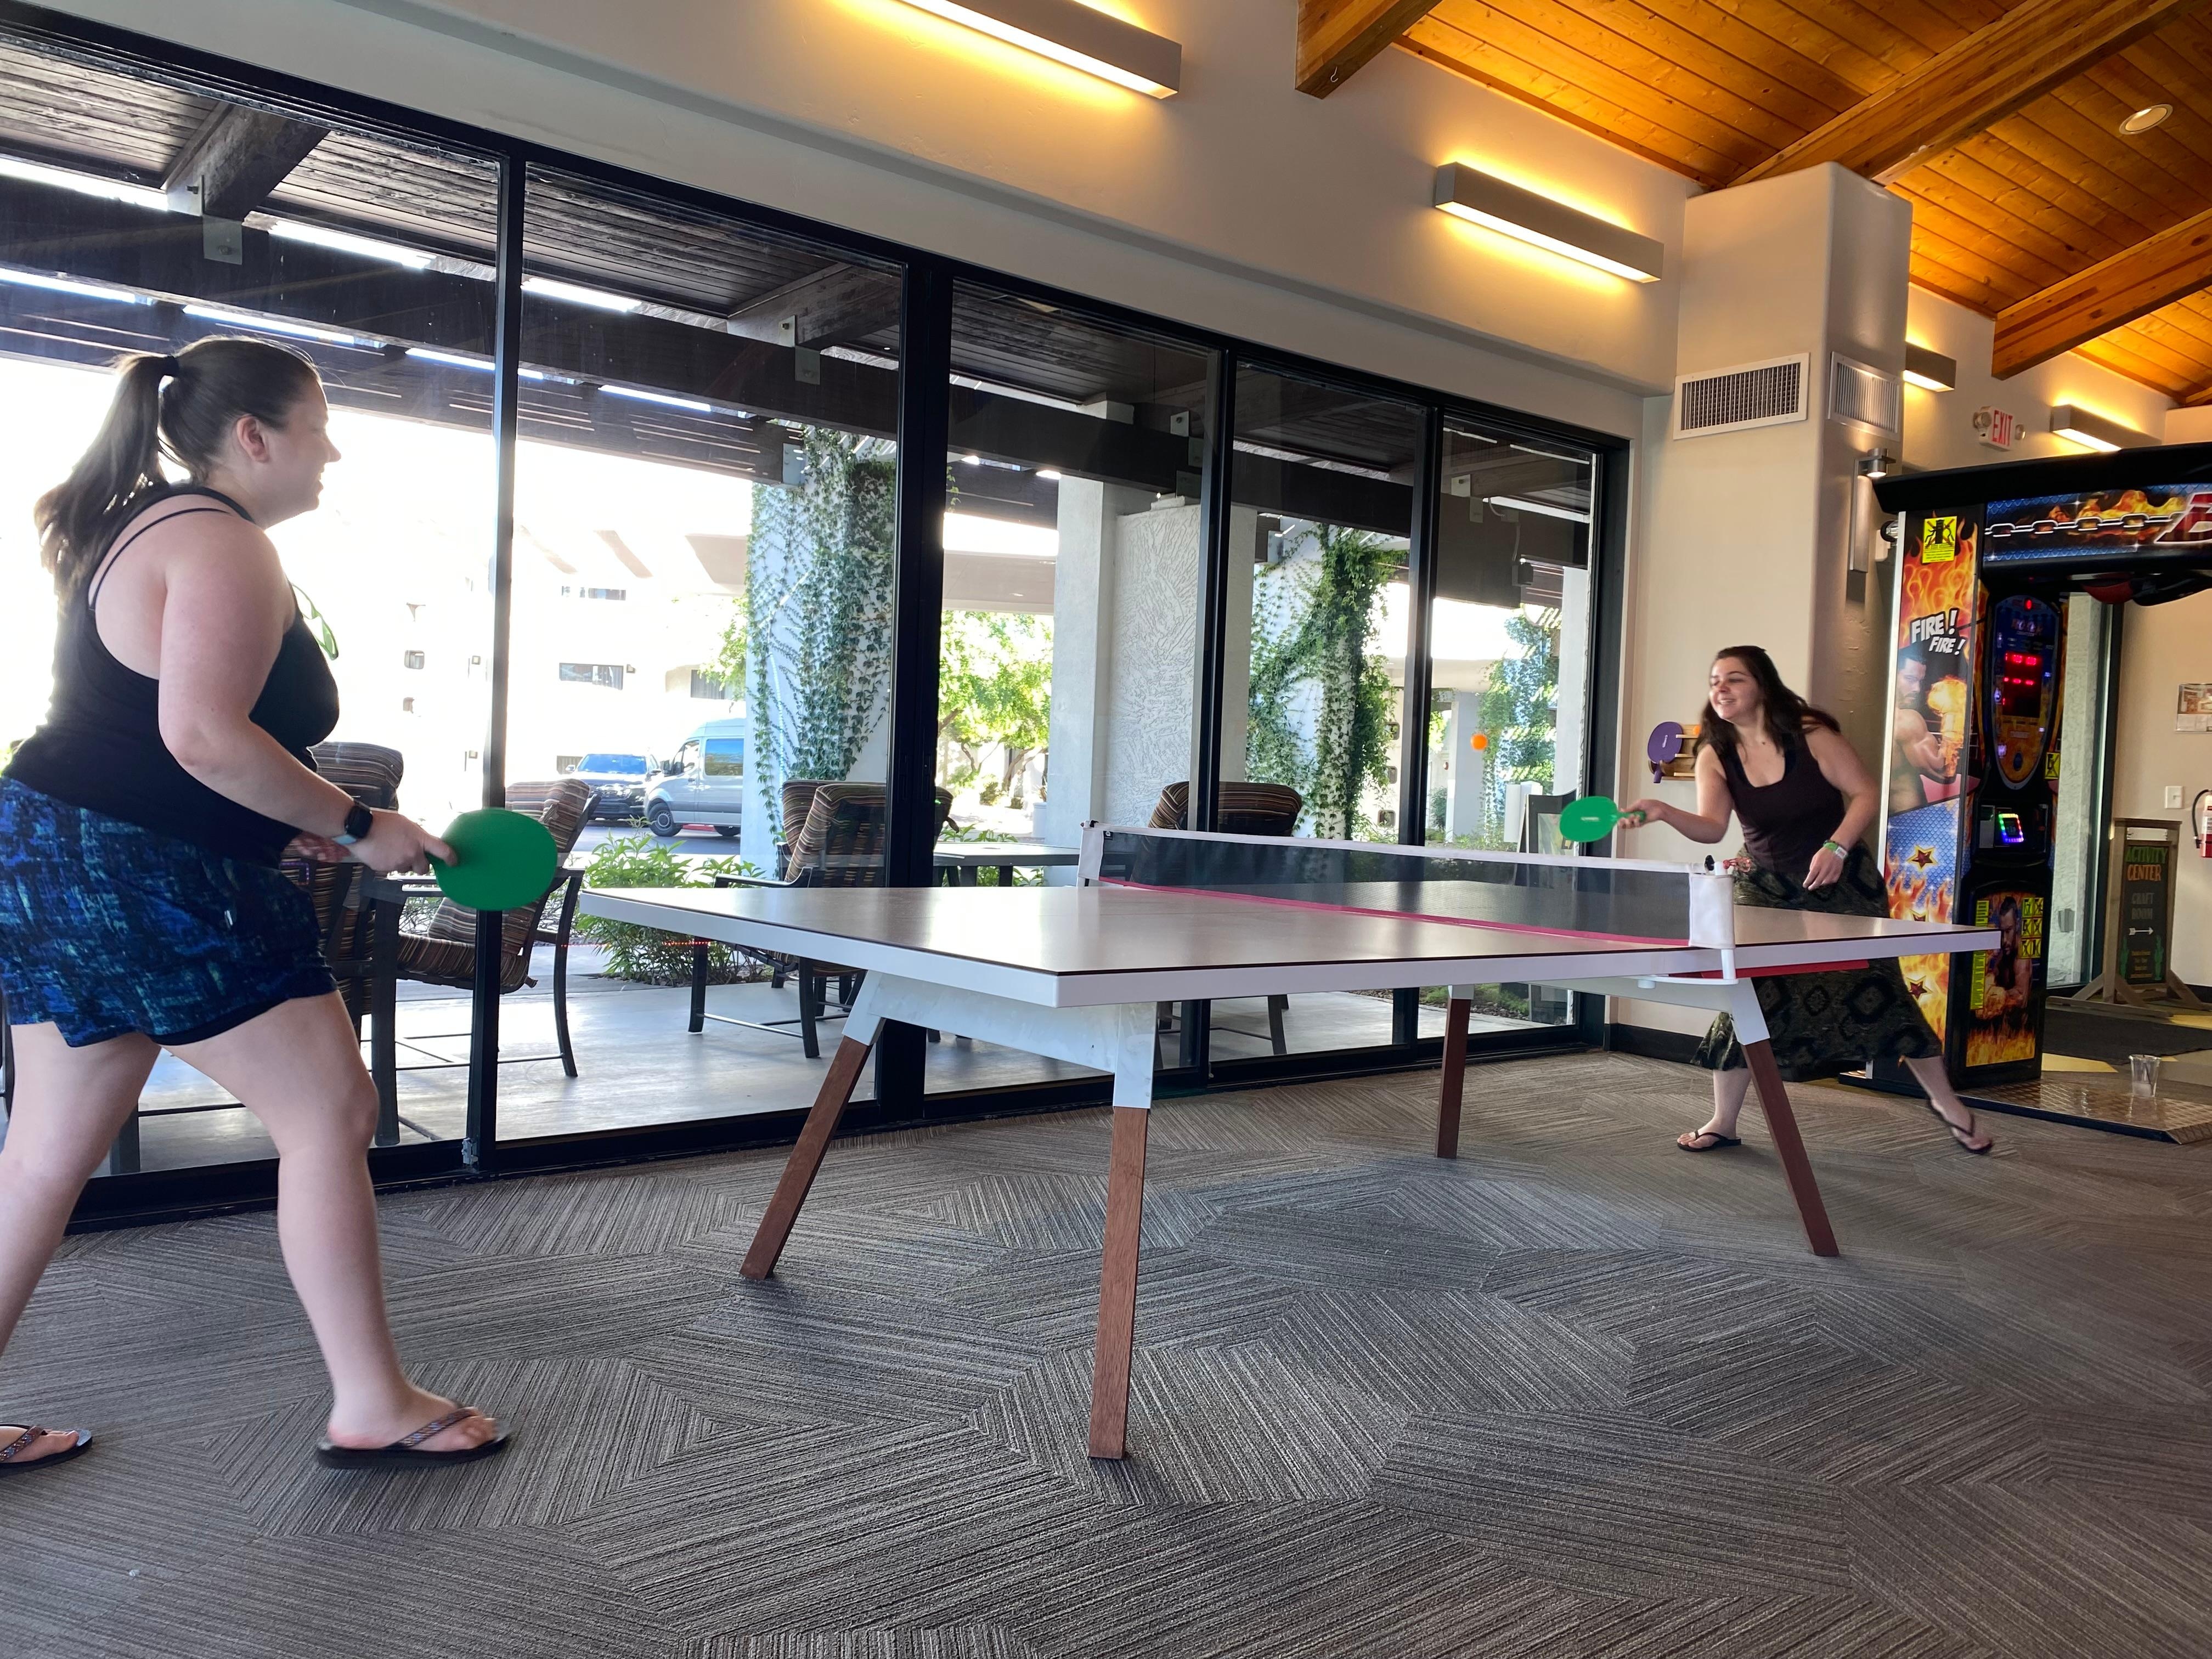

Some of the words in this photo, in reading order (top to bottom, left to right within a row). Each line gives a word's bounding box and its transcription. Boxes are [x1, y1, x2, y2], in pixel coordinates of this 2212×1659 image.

[1992, 410, 2013, 447] EXIT
[2125, 846, 2168, 864] ACTIVITY
[2127, 864, 2162, 882] CENTER
